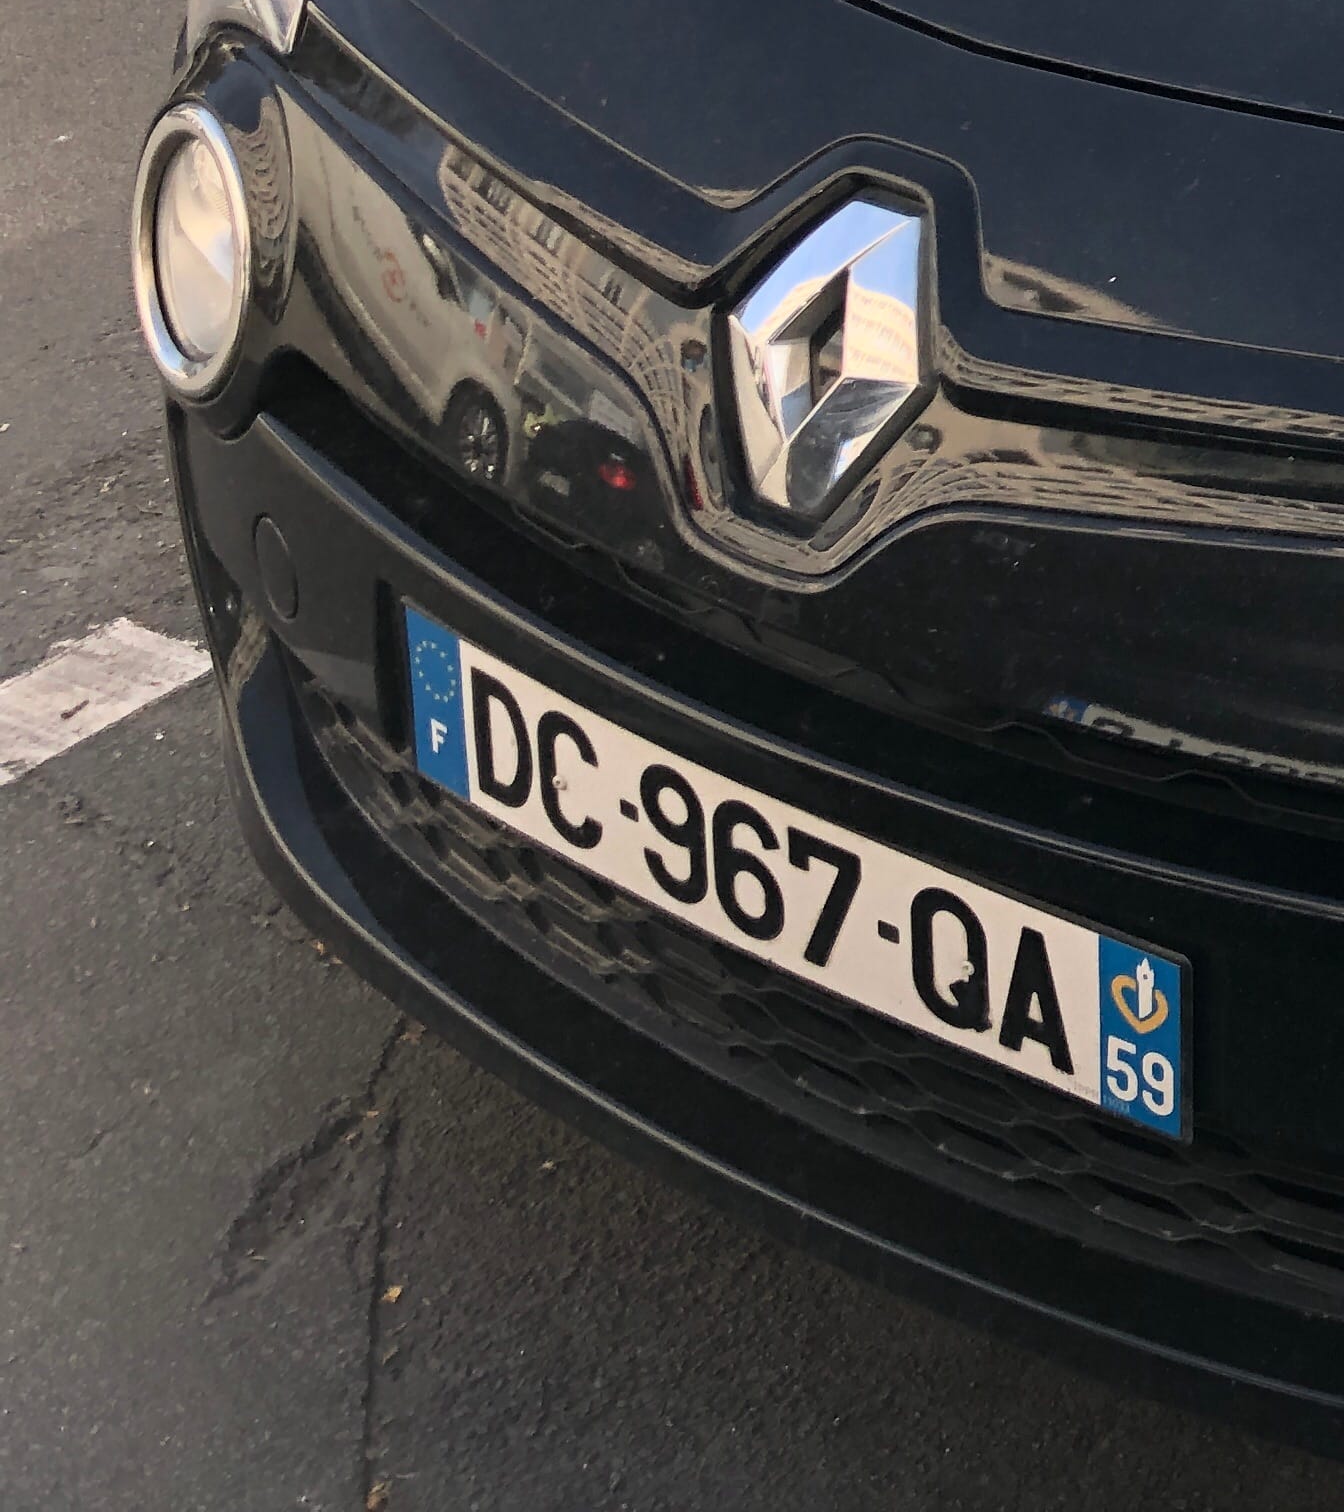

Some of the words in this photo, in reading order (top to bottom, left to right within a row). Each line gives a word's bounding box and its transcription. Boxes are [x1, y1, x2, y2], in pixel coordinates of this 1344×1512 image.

[430, 718, 448, 754] F
[470, 666, 1075, 1075] DC-967-QA
[1106, 1035, 1174, 1116] 59
